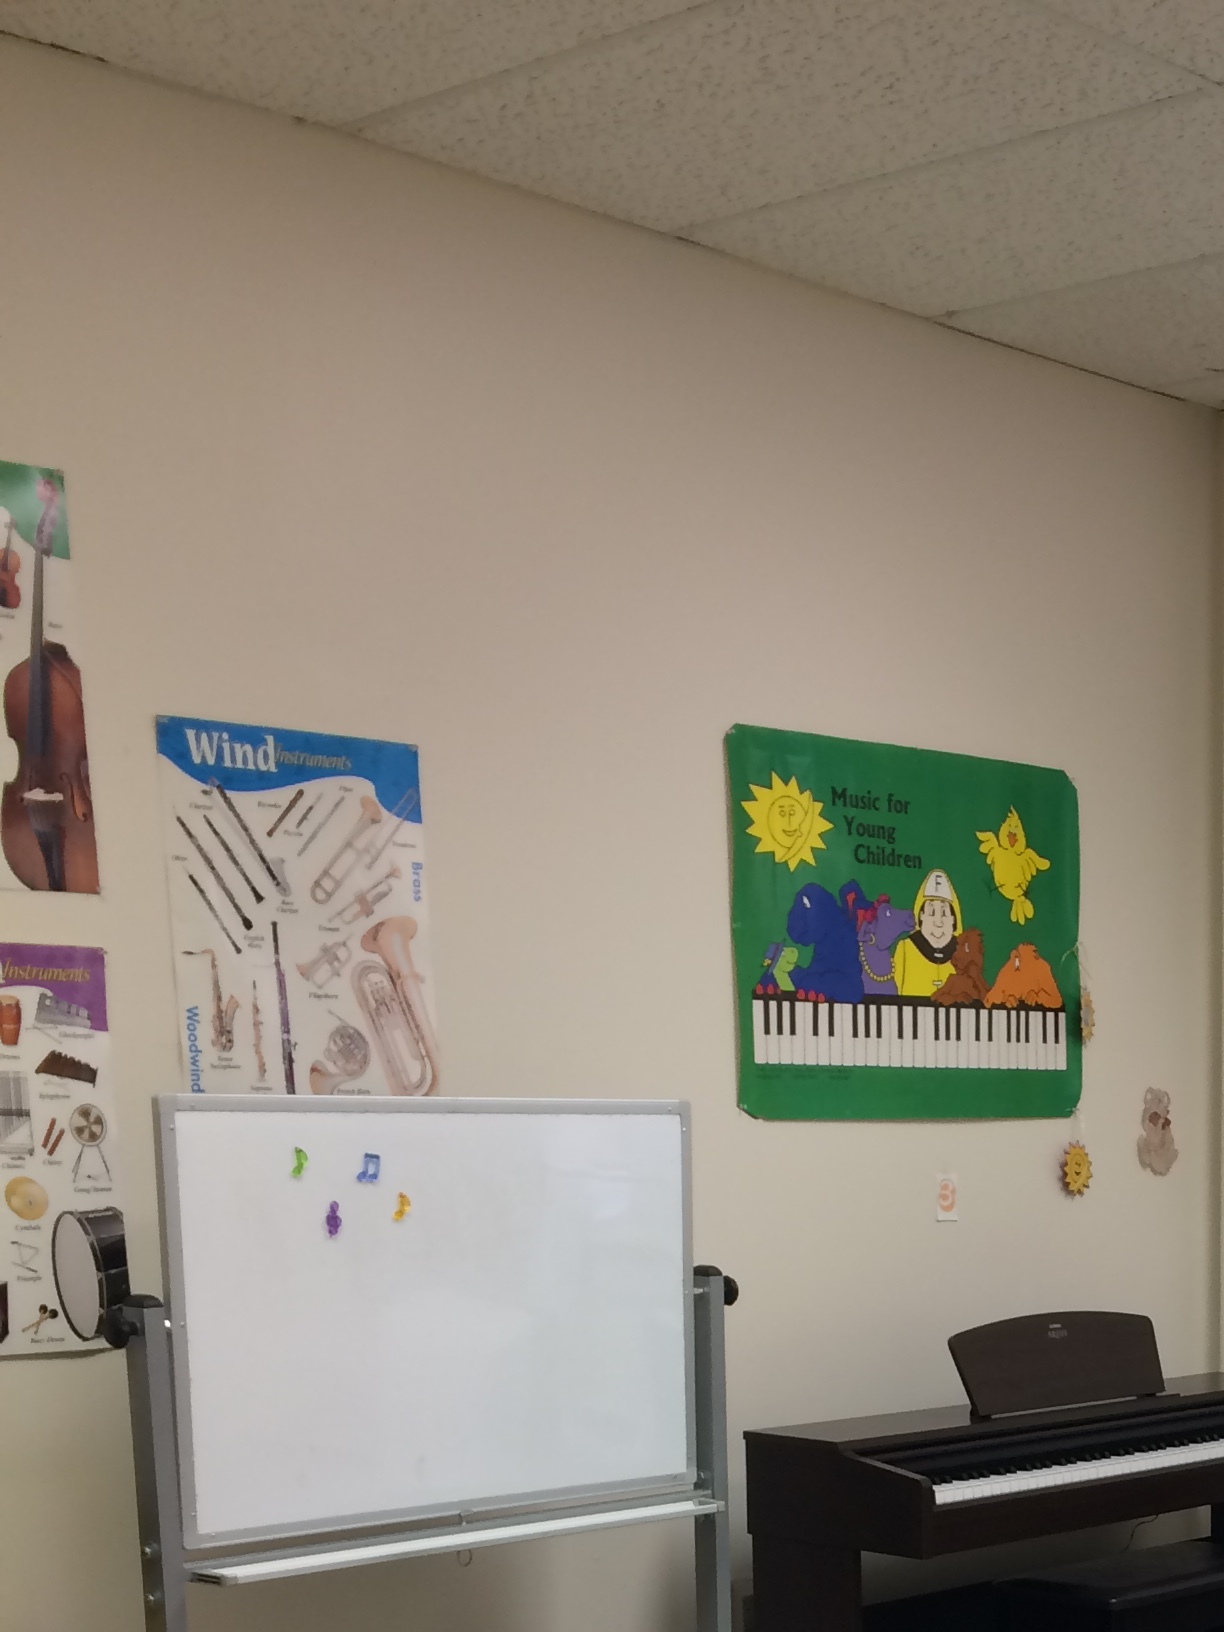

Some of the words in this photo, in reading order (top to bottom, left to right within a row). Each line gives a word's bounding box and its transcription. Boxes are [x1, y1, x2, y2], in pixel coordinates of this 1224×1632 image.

[185, 728, 278, 773] Wind
[274, 743, 352, 771] Instruments
[830, 786, 880, 811] Music
[887, 793, 910, 815] for
[843, 815, 896, 844] Young
[854, 843, 922, 869] Children
[411, 862, 423, 902] Brass
[935, 875, 942, 892] F
[3, 957, 91, 983] Instruments
